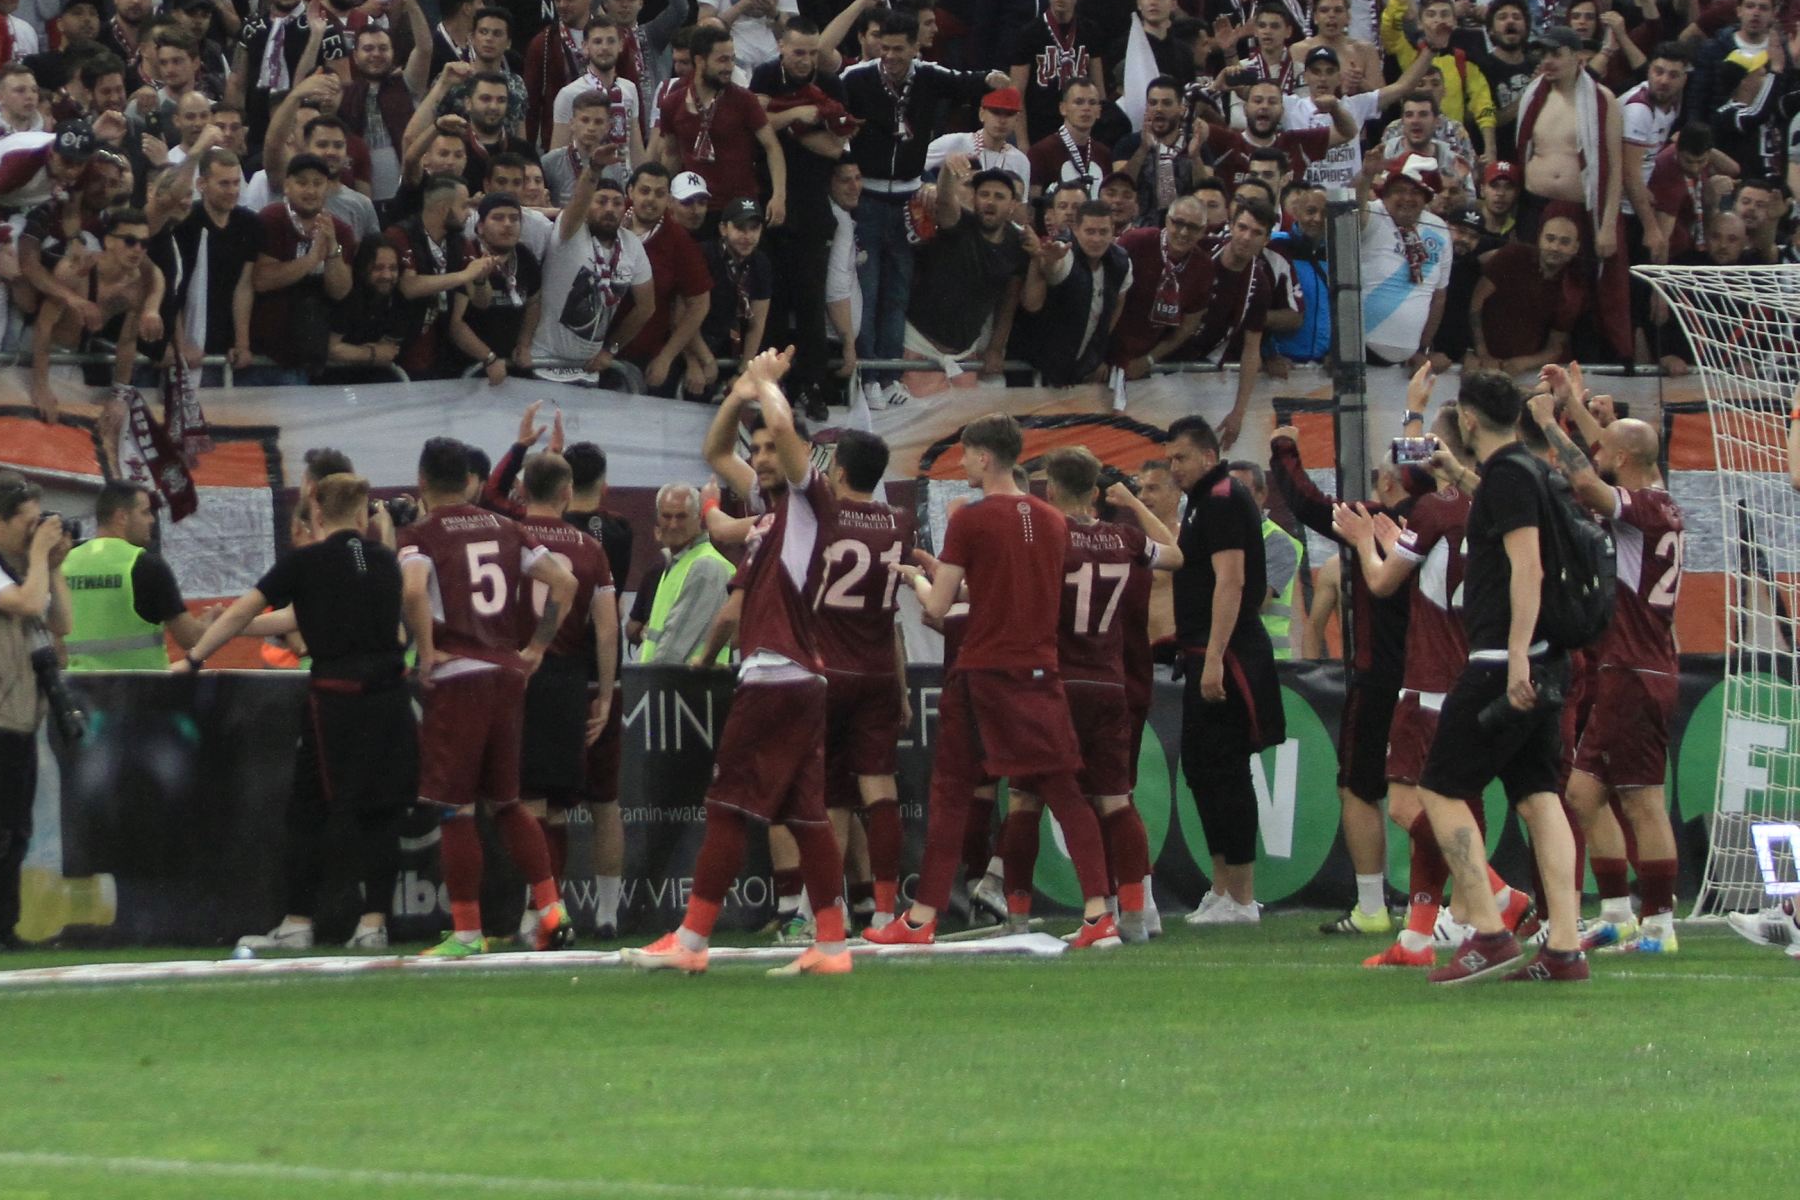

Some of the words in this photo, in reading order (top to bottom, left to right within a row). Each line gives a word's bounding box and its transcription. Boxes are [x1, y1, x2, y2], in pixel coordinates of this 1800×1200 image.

[467, 541, 508, 616] 5
[824, 539, 903, 609] 21
[1065, 561, 1131, 634] 17
[1648, 531, 1686, 606] 2
